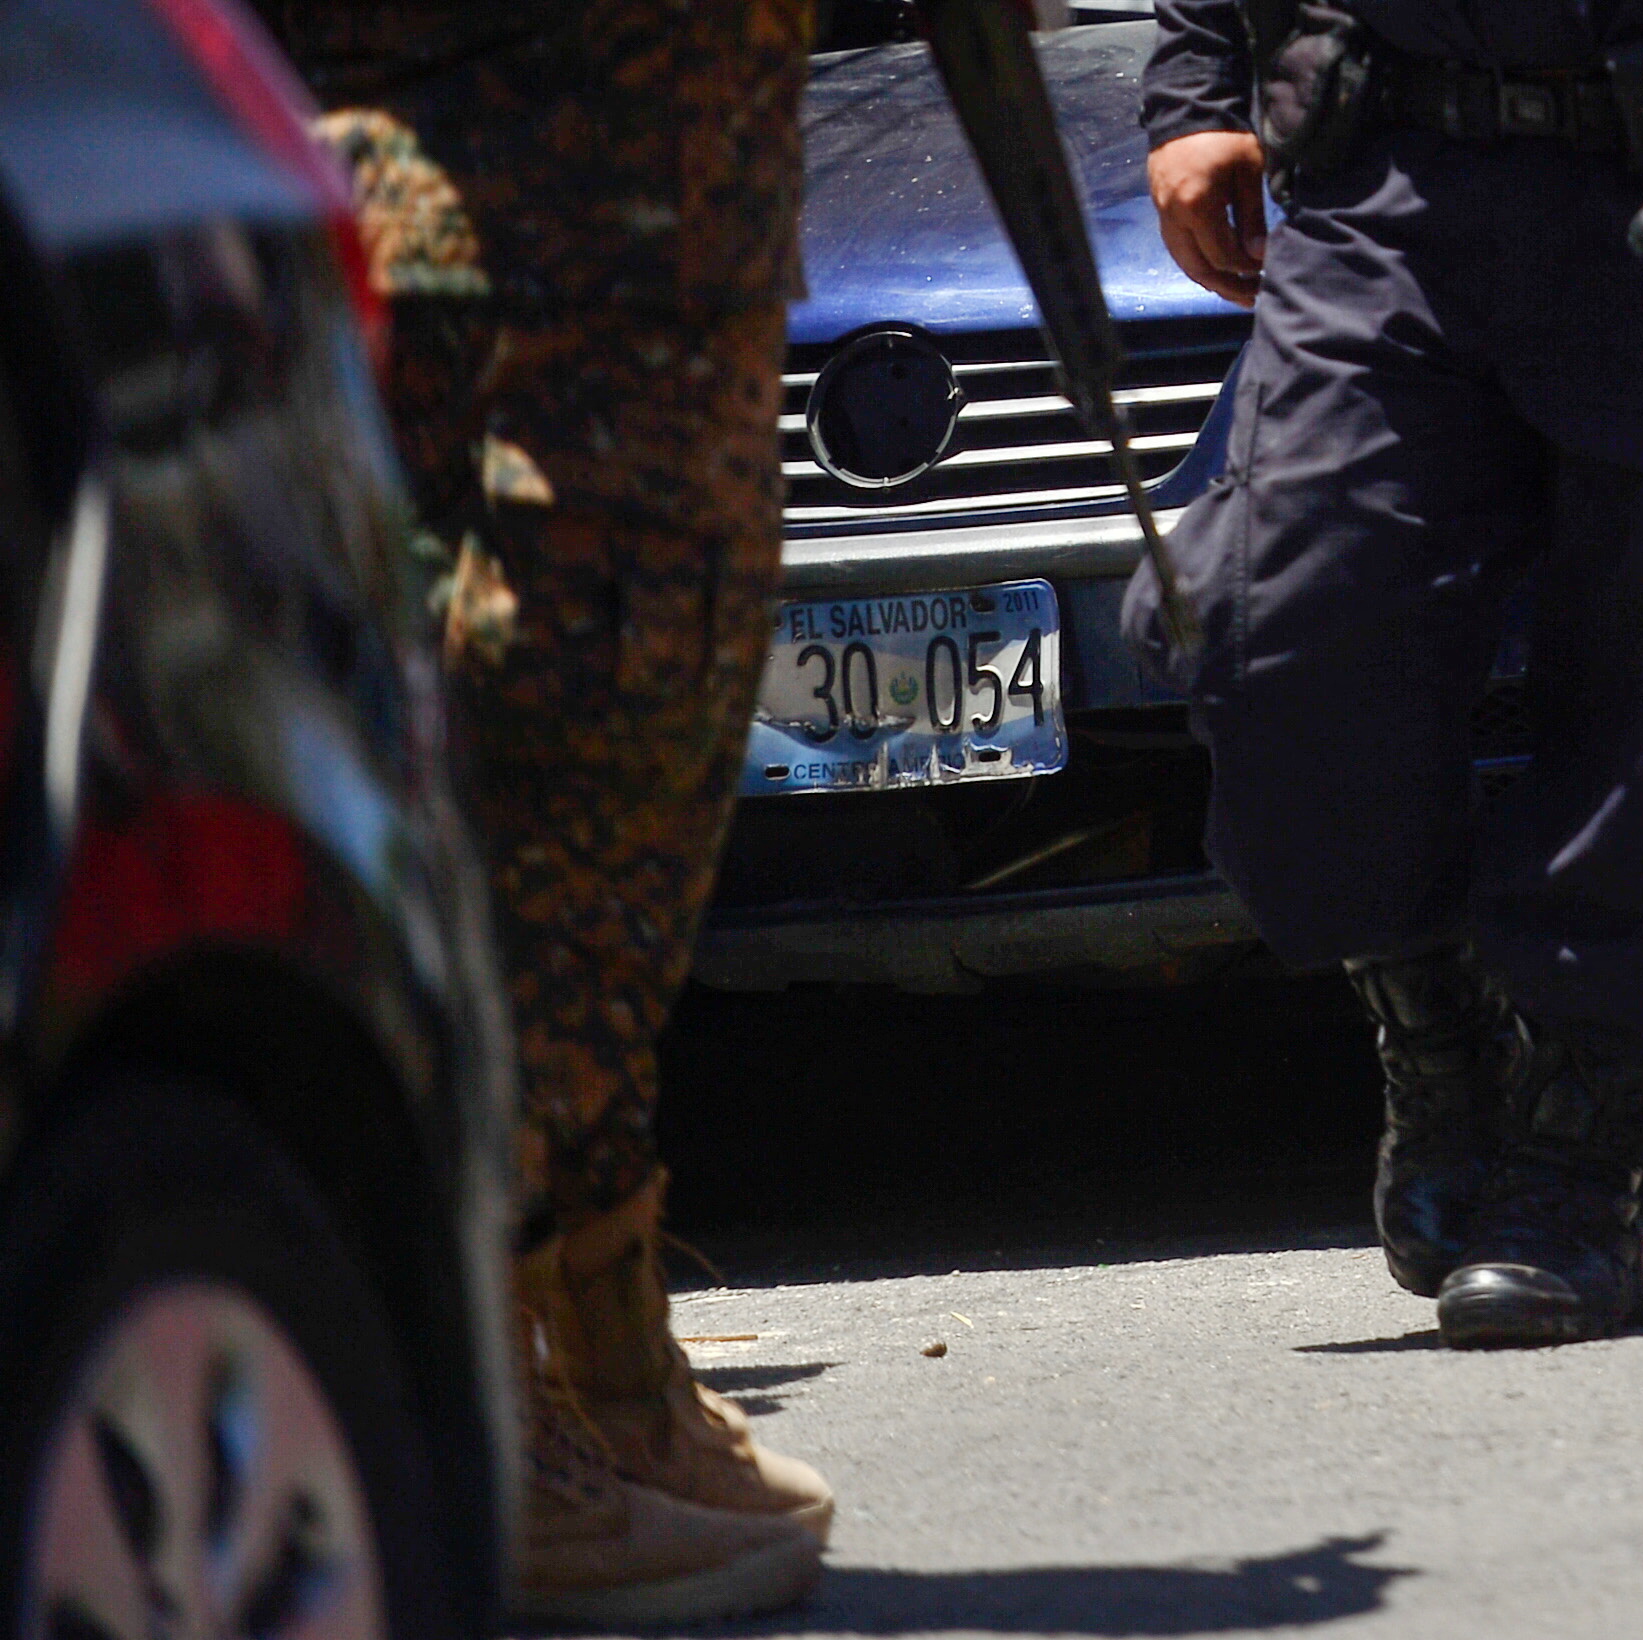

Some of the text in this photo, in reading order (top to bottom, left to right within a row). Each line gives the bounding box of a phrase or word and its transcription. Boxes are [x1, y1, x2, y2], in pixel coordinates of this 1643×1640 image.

[790, 591, 1039, 642] EL SALVADOR 2011
[926, 627, 1045, 739] 054
